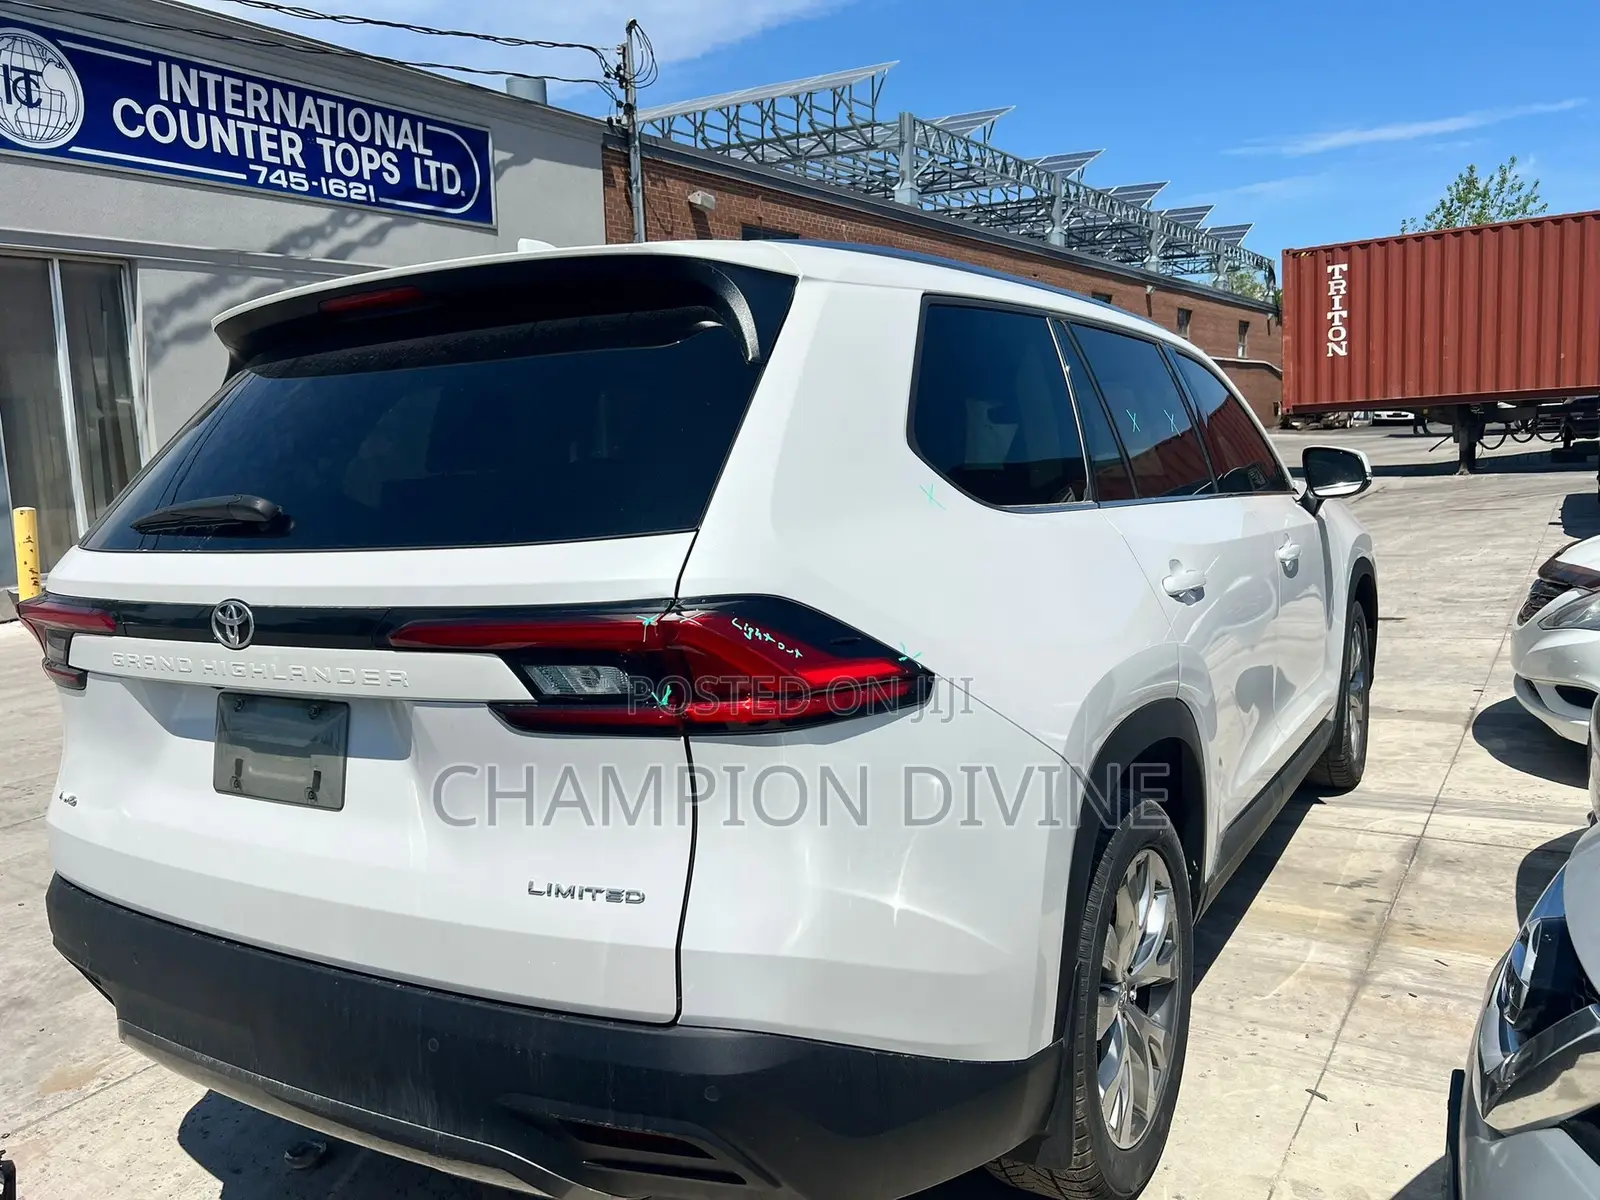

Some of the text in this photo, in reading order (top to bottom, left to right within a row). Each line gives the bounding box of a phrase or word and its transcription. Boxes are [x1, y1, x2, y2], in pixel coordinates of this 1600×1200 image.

[157, 60, 434, 157] INTERNATIONAL
[112, 97, 466, 197] COUNTER TOPS LTD.
[248, 164, 376, 203] 745-1621
[1326, 263, 1348, 357] TRITON
[111, 651, 410, 688] GRAND HIGHLANDER
[527, 880, 646, 905] LIMITED
